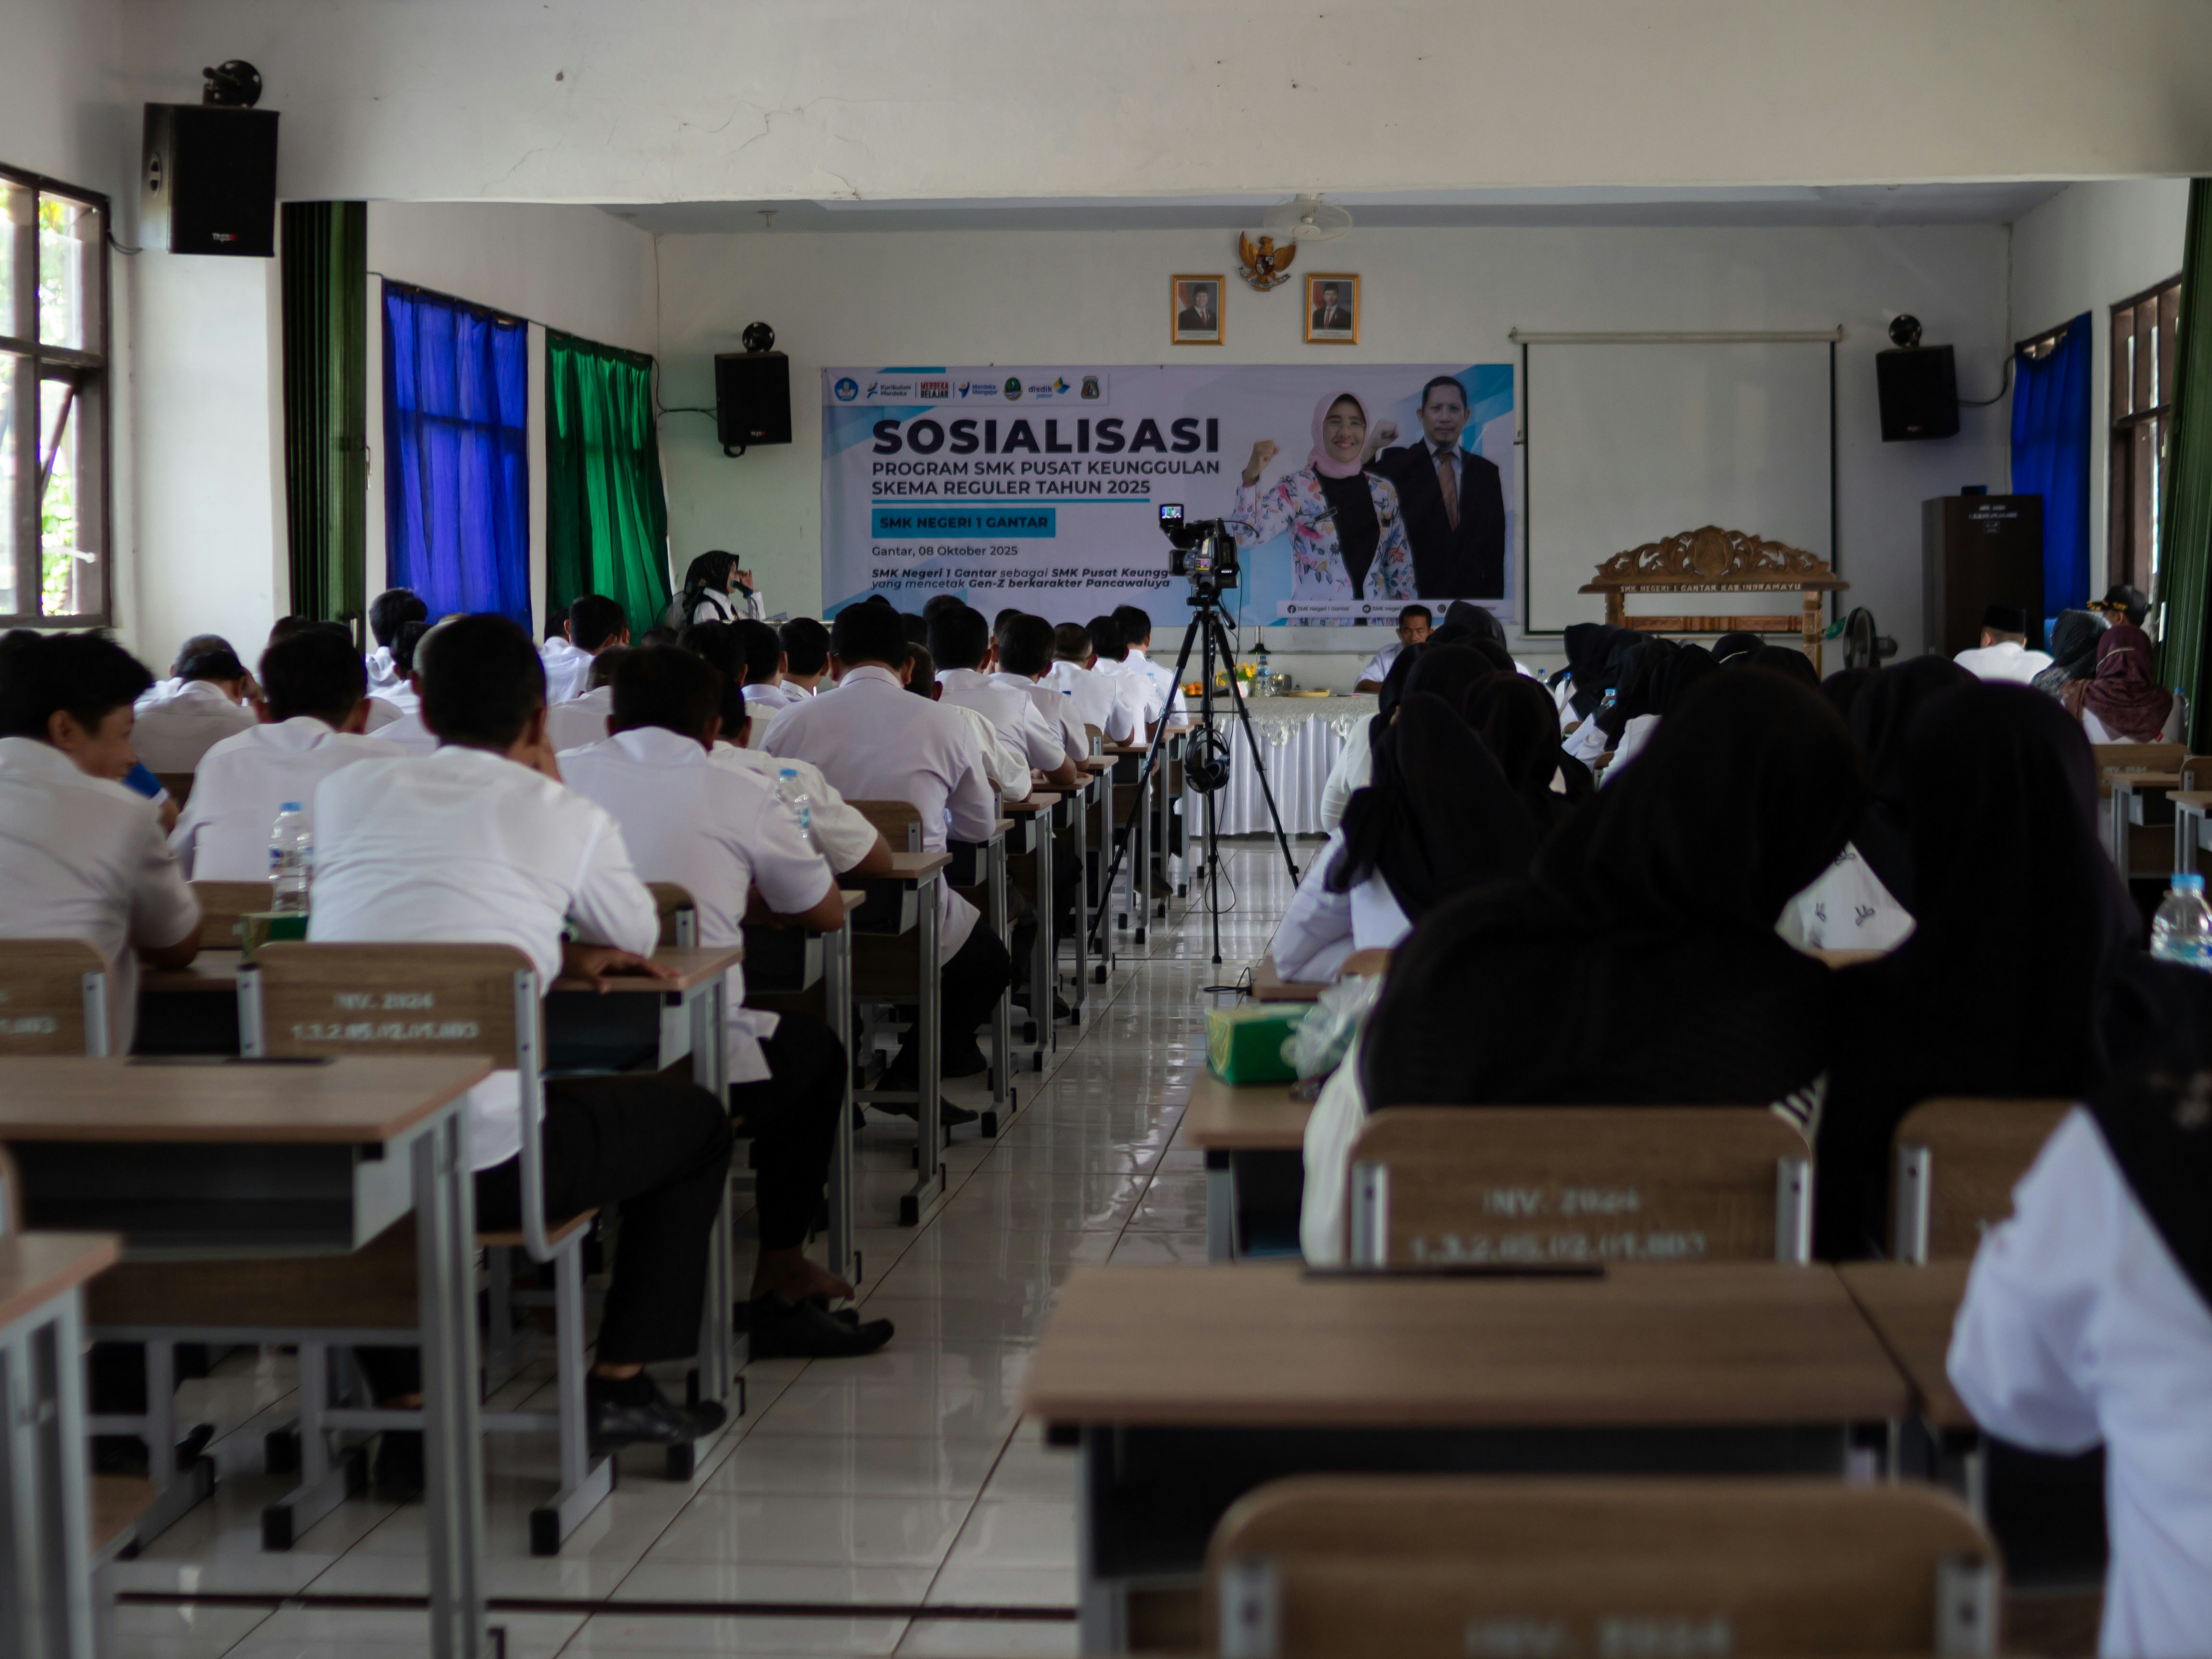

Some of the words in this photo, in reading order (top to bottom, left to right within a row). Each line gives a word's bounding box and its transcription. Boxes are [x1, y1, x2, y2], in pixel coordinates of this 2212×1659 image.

[920, 382, 949, 390] MERDEKA
[920, 390, 949, 398] BELAJAR
[872, 419, 1218, 455] SOSIALISASI
[873, 462, 968, 476] PROGRAM
[974, 462, 1014, 475] SMK
[1021, 461, 1082, 475] PUSAT
[1088, 461, 1219, 474] KEUNGGULAN
[872, 481, 938, 495] SKEMA
[944, 481, 1031, 494] REGULER
[1035, 481, 1101, 494] TAHUN
[1107, 480, 1150, 493] 2025
[880, 517, 912, 528] SMK
[917, 517, 972, 528] NEGERI
[976, 517, 982, 528] 1
[986, 517, 1048, 528] GANTAR
[872, 546, 915, 557] Gantar,
[918, 546, 934, 556] 08
[937, 546, 987, 556] Oktober
[989, 546, 1018, 555] 2025
[871, 569, 899, 578] SMK
[902, 568, 943, 580] Negeri
[946, 569, 951, 577] 1
[954, 569, 997, 578] Gantar
[1001, 568, 1048, 580] sebagai
[1051, 568, 1078, 577] SMK
[1082, 568, 1118, 577] Pusat
[1121, 568, 1168, 579] Keungg
[871, 580, 902, 591] yang
[905, 579, 965, 589] mencetak
[968, 579, 1005, 588] Gen-Z
[1008, 578, 1082, 588] berkarakter
[1086, 578, 1170, 589] Pancawaluya
